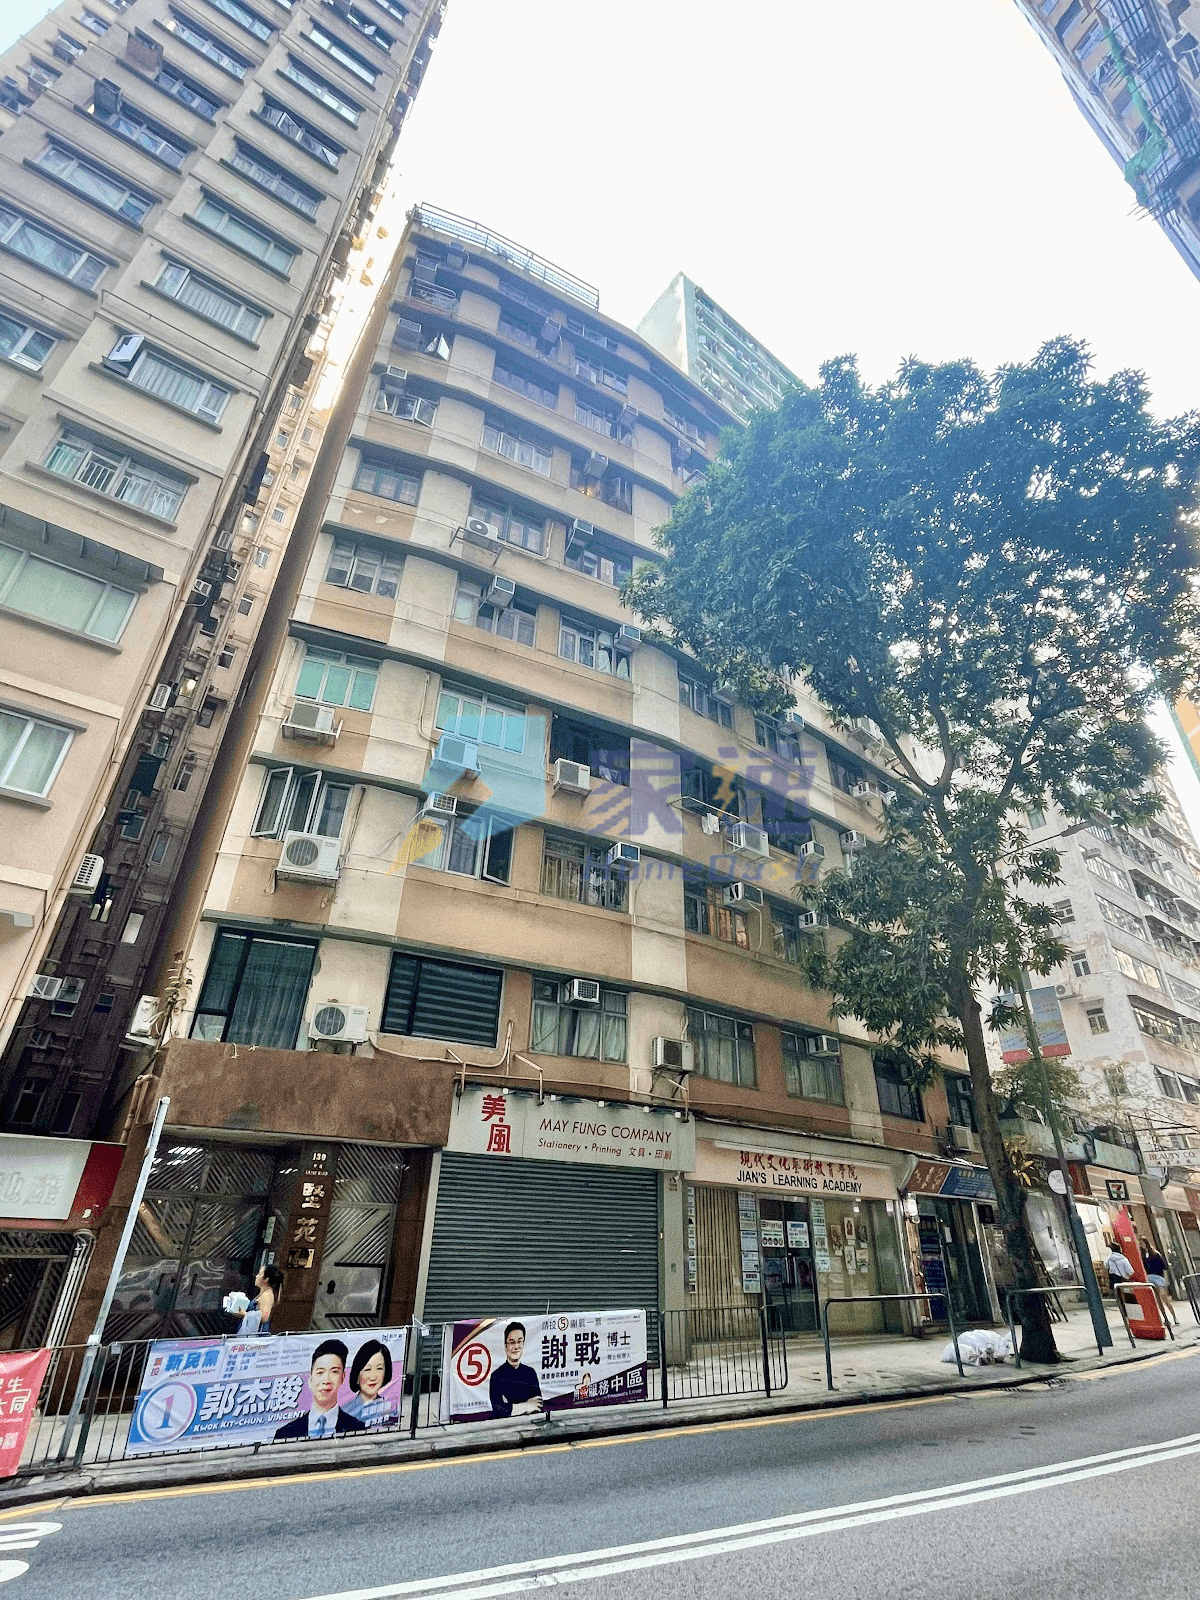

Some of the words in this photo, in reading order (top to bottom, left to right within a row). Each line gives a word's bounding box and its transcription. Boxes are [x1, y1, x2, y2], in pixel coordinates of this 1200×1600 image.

[539, 1118, 569, 1132] MAY
[572, 1121, 607, 1137] FUNG
[611, 1125, 672, 1144] COMPANY
[538, 1138, 581, 1152] Stationery
[591, 1142, 622, 1157] Printing
[1149, 1152, 1181, 1161] BEAUTY
[736, 1170, 767, 1184] JIAN'S
[772, 1173, 818, 1189] LEARNING
[822, 1179, 862, 1194] ACADEMY
[606, 1330, 631, 1347] 博士
[541, 1331, 601, 1370] 謝戰
[193, 1422, 219, 1432] KWOK
[267, 1410, 306, 1422] VINCENT
